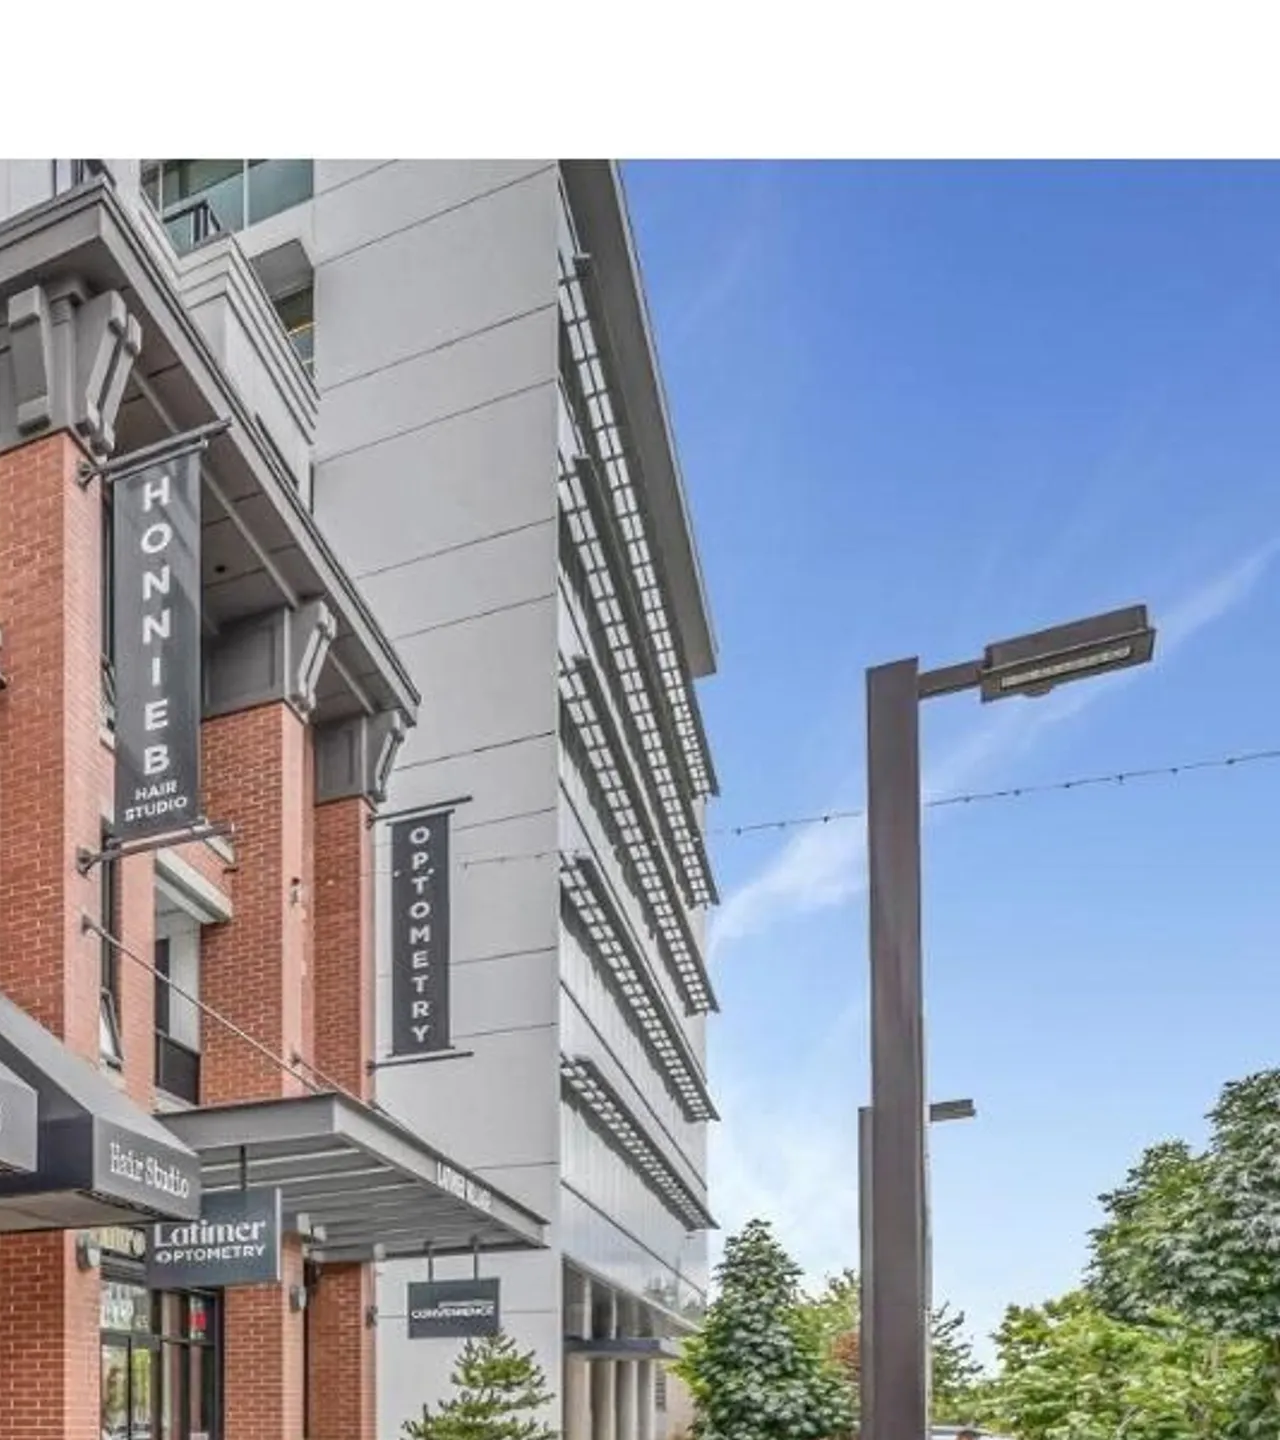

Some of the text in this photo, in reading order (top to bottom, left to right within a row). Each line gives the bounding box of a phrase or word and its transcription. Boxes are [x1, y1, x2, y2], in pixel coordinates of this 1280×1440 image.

[135, 780, 178, 801] HAIR
[125, 796, 189, 822] STUDIO
[409, 826, 431, 1043] OPTOMETRY
[110, 1142, 190, 1199] Hair Studio
[154, 1219, 266, 1248] Latimer
[155, 1245, 266, 1264] OPTOMETRY
